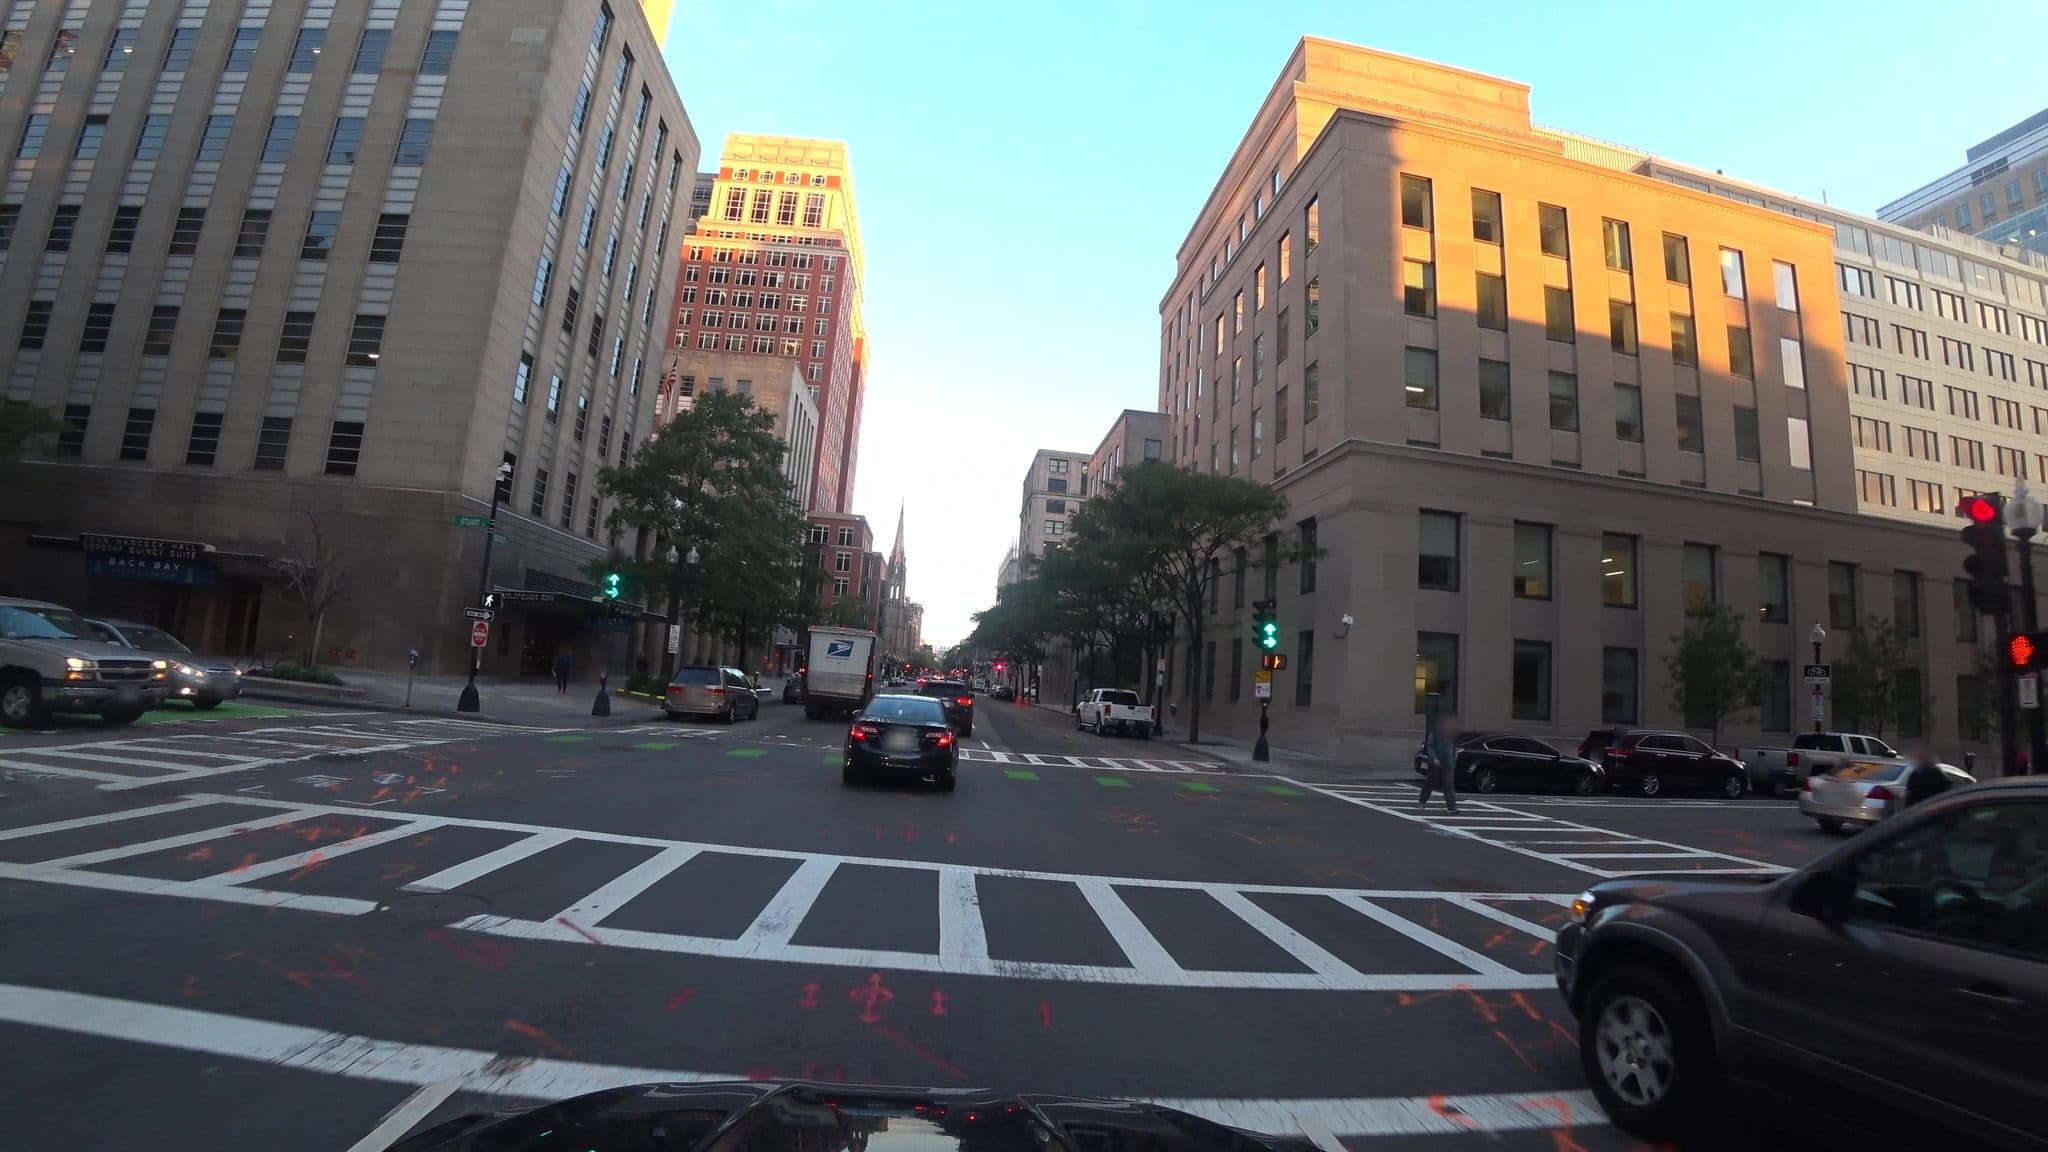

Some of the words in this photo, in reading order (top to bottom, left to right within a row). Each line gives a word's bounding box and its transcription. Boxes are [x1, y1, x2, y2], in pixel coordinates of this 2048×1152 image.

[170, 550, 196, 559] SUITE
[108, 558, 145, 568] BACK
[153, 562, 181, 571] BAY
